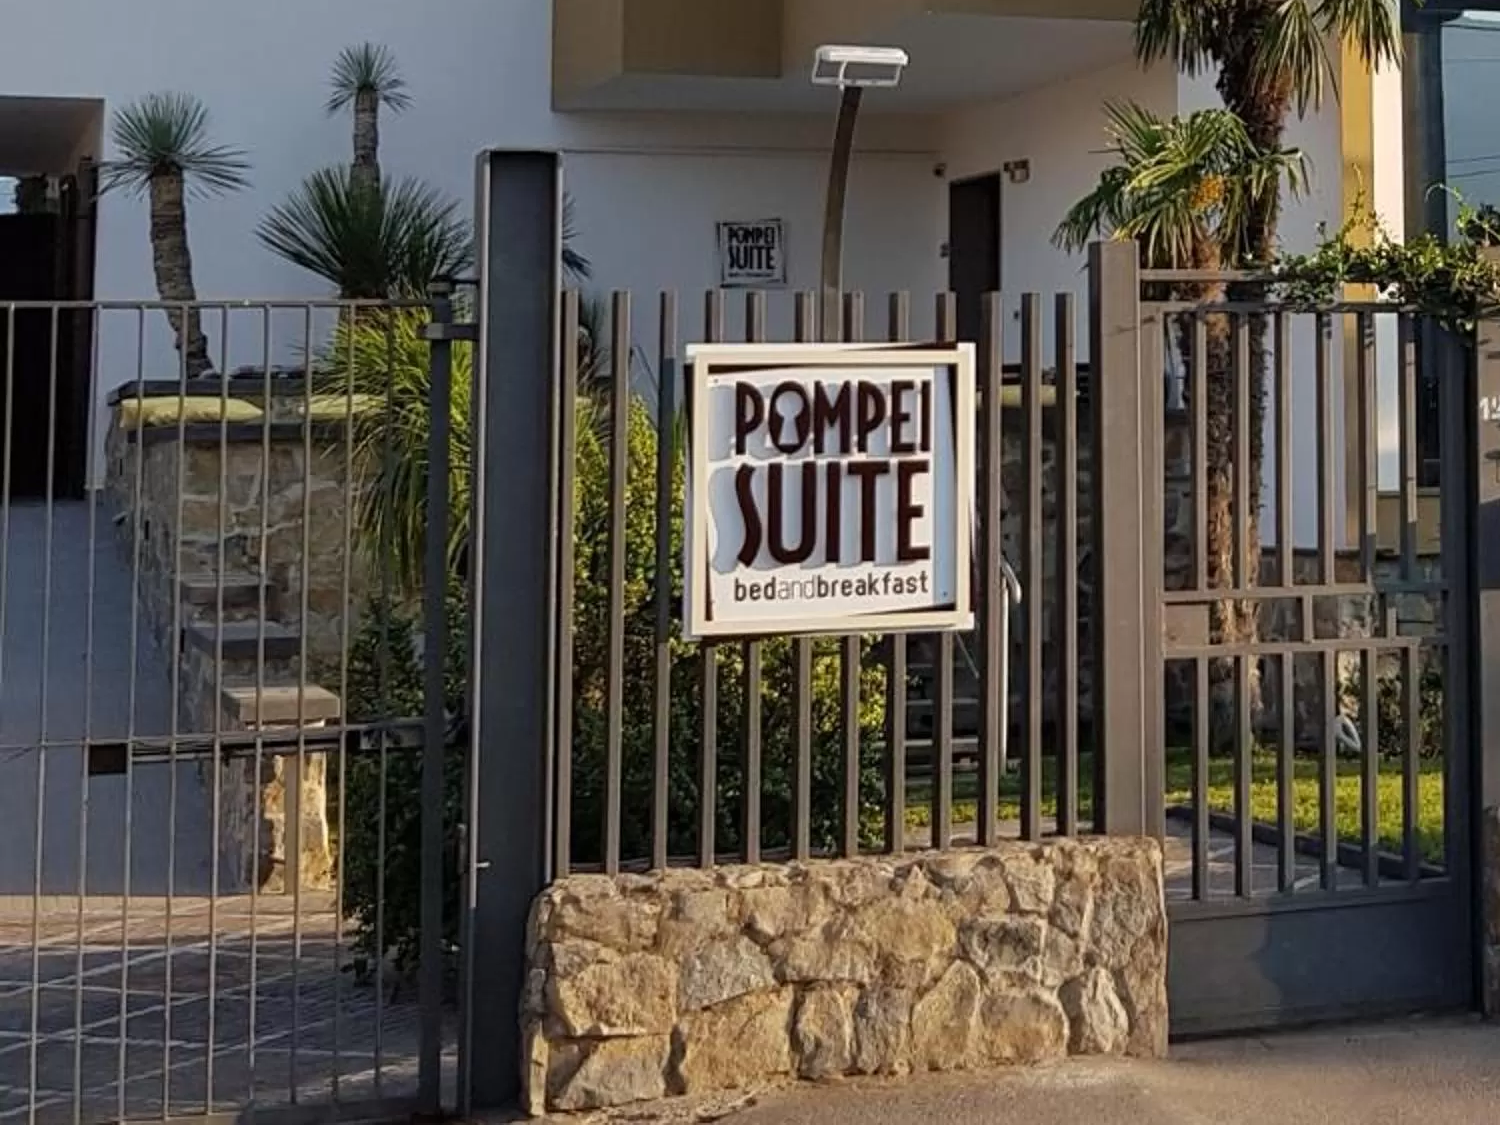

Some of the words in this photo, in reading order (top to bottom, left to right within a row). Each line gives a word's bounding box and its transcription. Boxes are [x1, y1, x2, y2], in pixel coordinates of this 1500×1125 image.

[727, 226, 775, 244] POMPEI
[727, 246, 775, 270] SUITE
[735, 380, 932, 455] POMPEI
[734, 460, 931, 568] SUITE
[734, 572, 929, 602] bedandbreakfast
